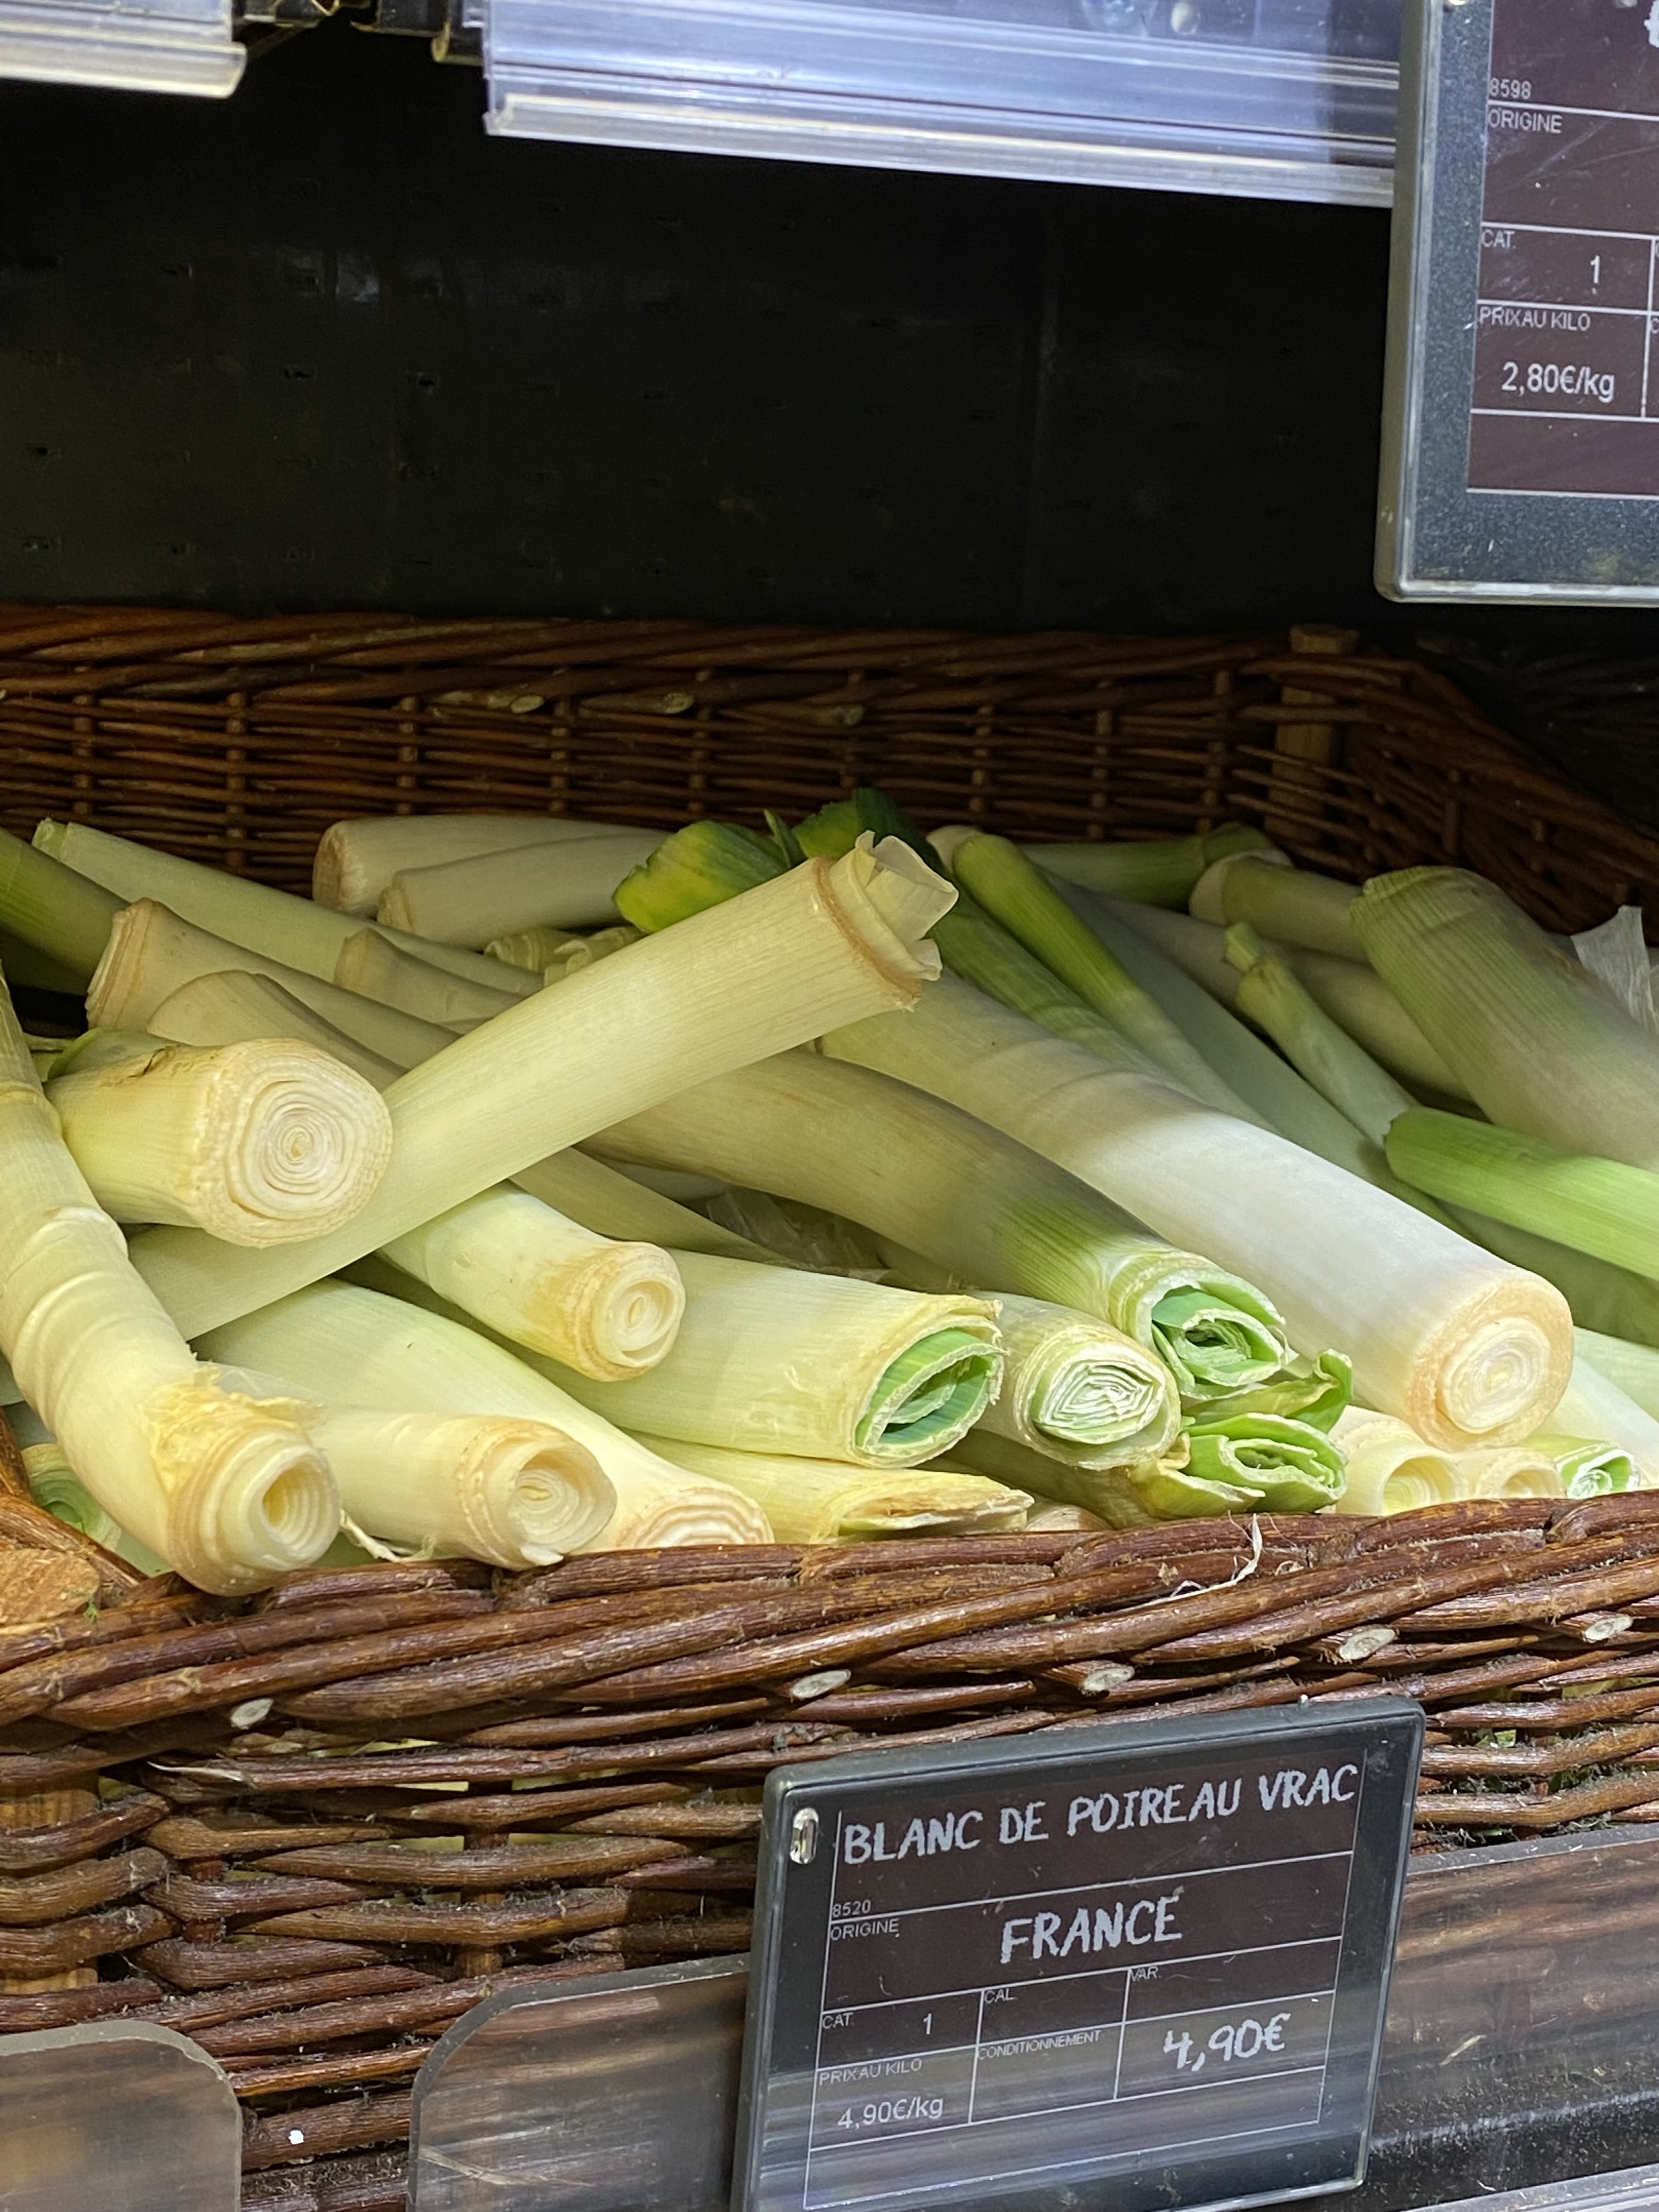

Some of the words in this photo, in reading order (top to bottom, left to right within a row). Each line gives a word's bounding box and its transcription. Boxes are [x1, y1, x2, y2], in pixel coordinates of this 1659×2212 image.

[1488, 78, 1531, 100] 8598
[1488, 109, 1562, 134] ORIGINE
[1590, 255, 1601, 284] 1
[1551, 313, 1591, 331] KILO
[1501, 362, 1615, 402] 2,80€/kg
[844, 1809, 983, 1865] BLANC
[998, 1801, 1049, 1844] DE
[1259, 1764, 1358, 1811] VRAC
[832, 1899, 871, 1917] 8520
[831, 1919, 899, 1941] ORIGINE
[1000, 1897, 1183, 1964] FRANCE
[923, 2013, 933, 2035] 1
[978, 2030, 1102, 2060] CONDITIONNEMENT
[1163, 2012, 1291, 2072] 4,90€
[885, 2058, 922, 2077] KILO
[837, 2097, 944, 2131] 4,90€/kg
